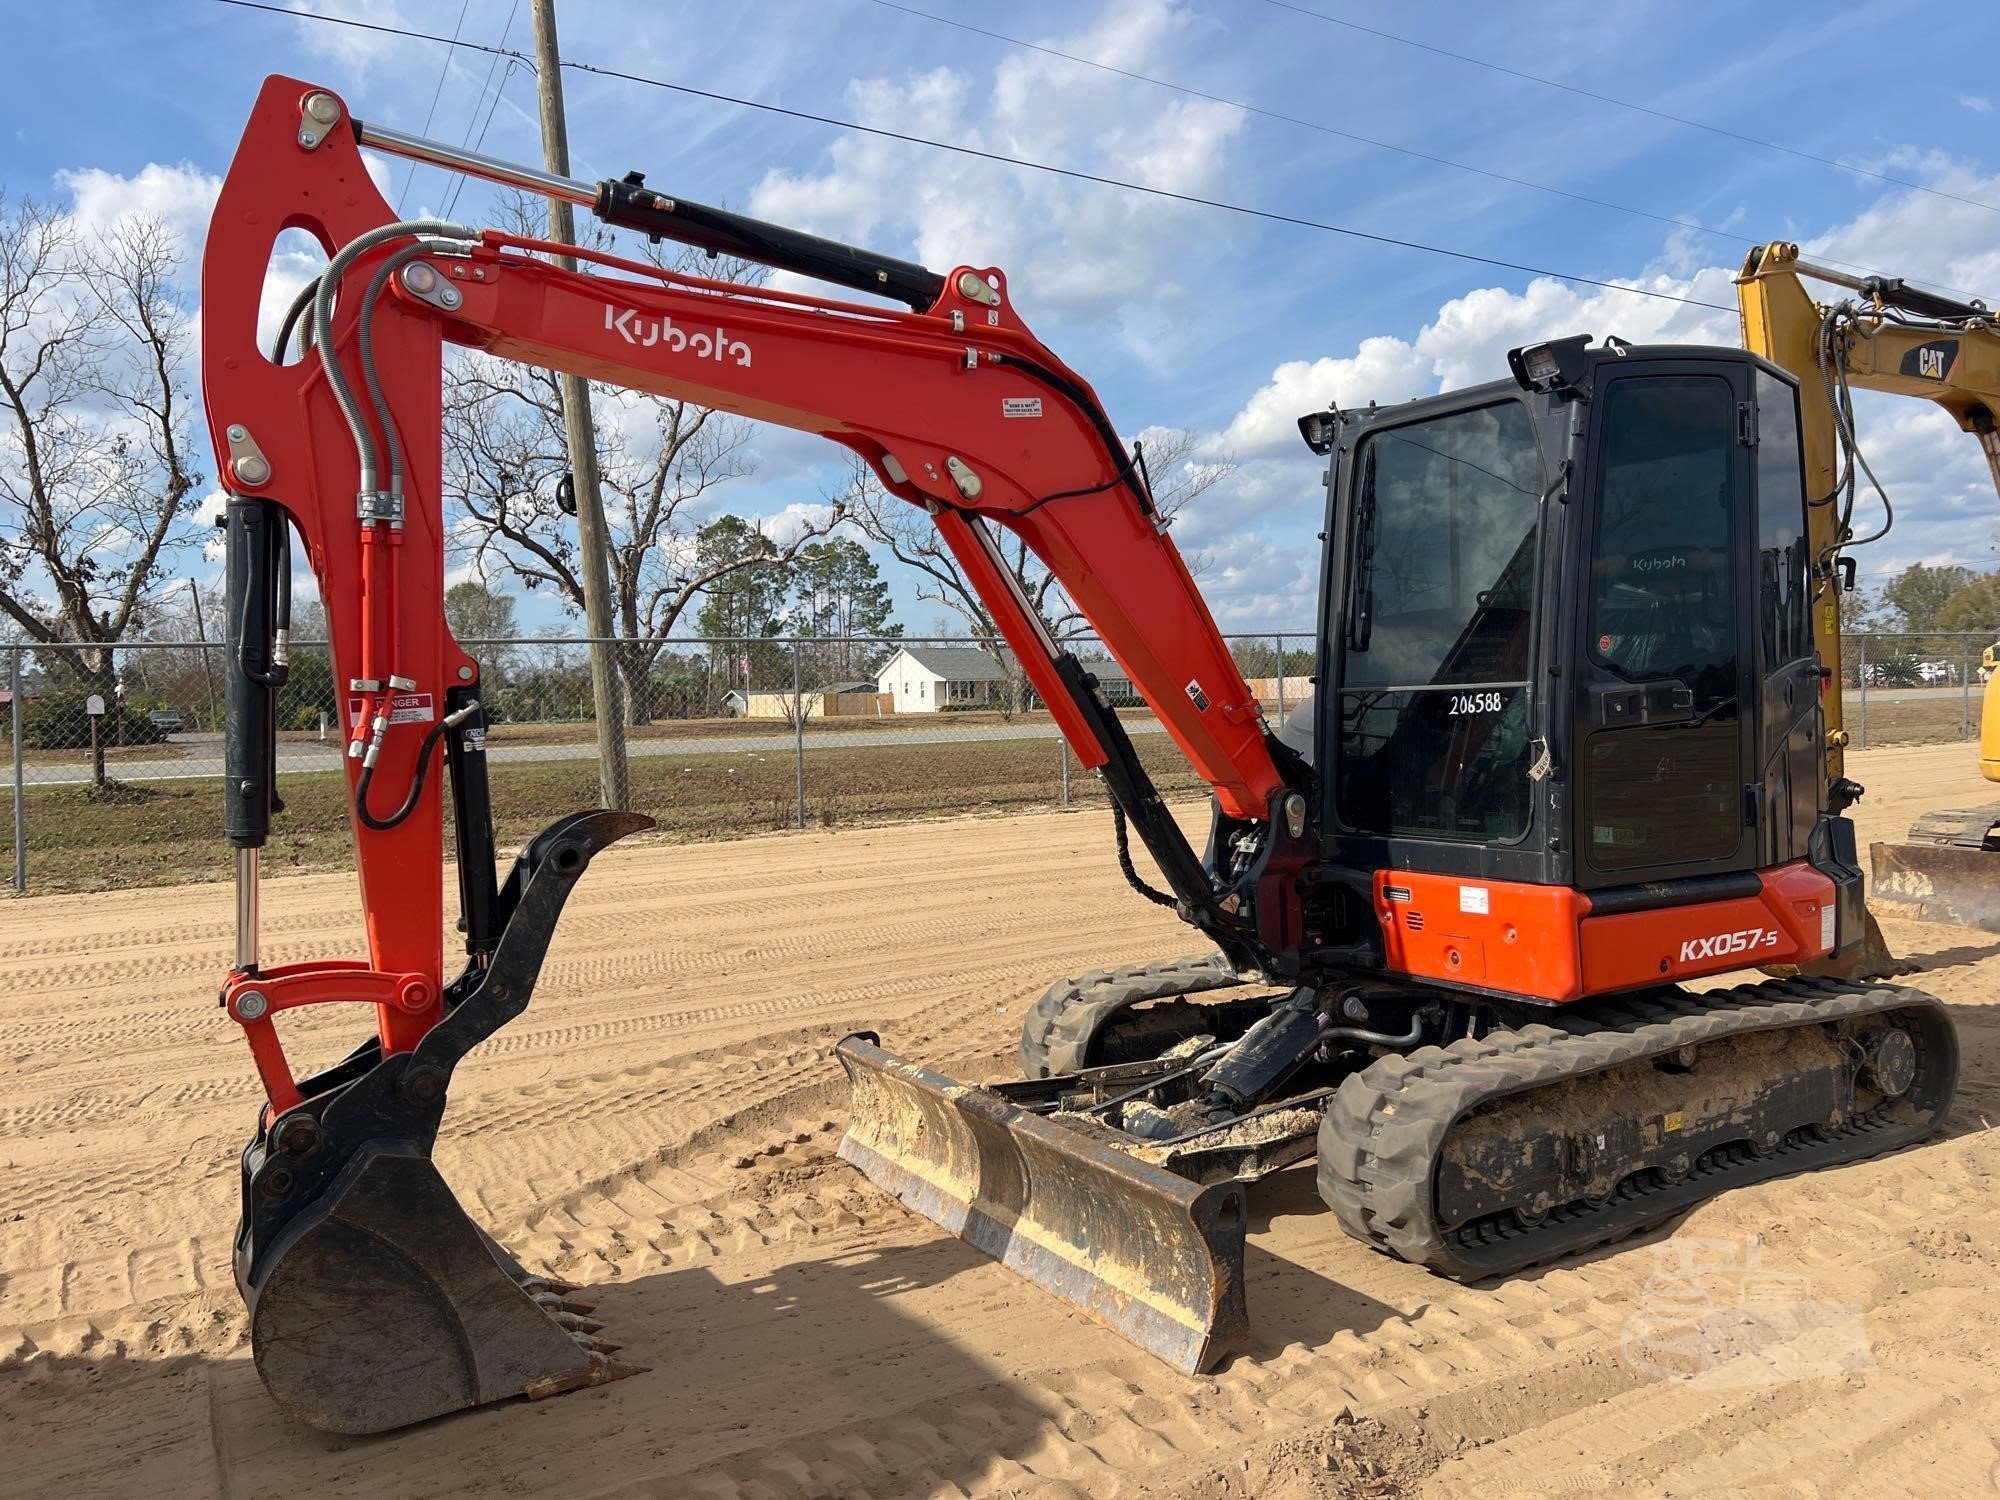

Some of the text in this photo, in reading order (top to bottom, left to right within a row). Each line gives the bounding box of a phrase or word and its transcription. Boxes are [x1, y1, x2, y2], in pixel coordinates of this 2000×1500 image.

[605, 304, 752, 367] Kubota
[1920, 347, 1944, 378] CAT
[1633, 555, 1686, 571] Kubota
[1448, 692, 1502, 715] 206588
[1680, 928, 1778, 962] KX057-5
